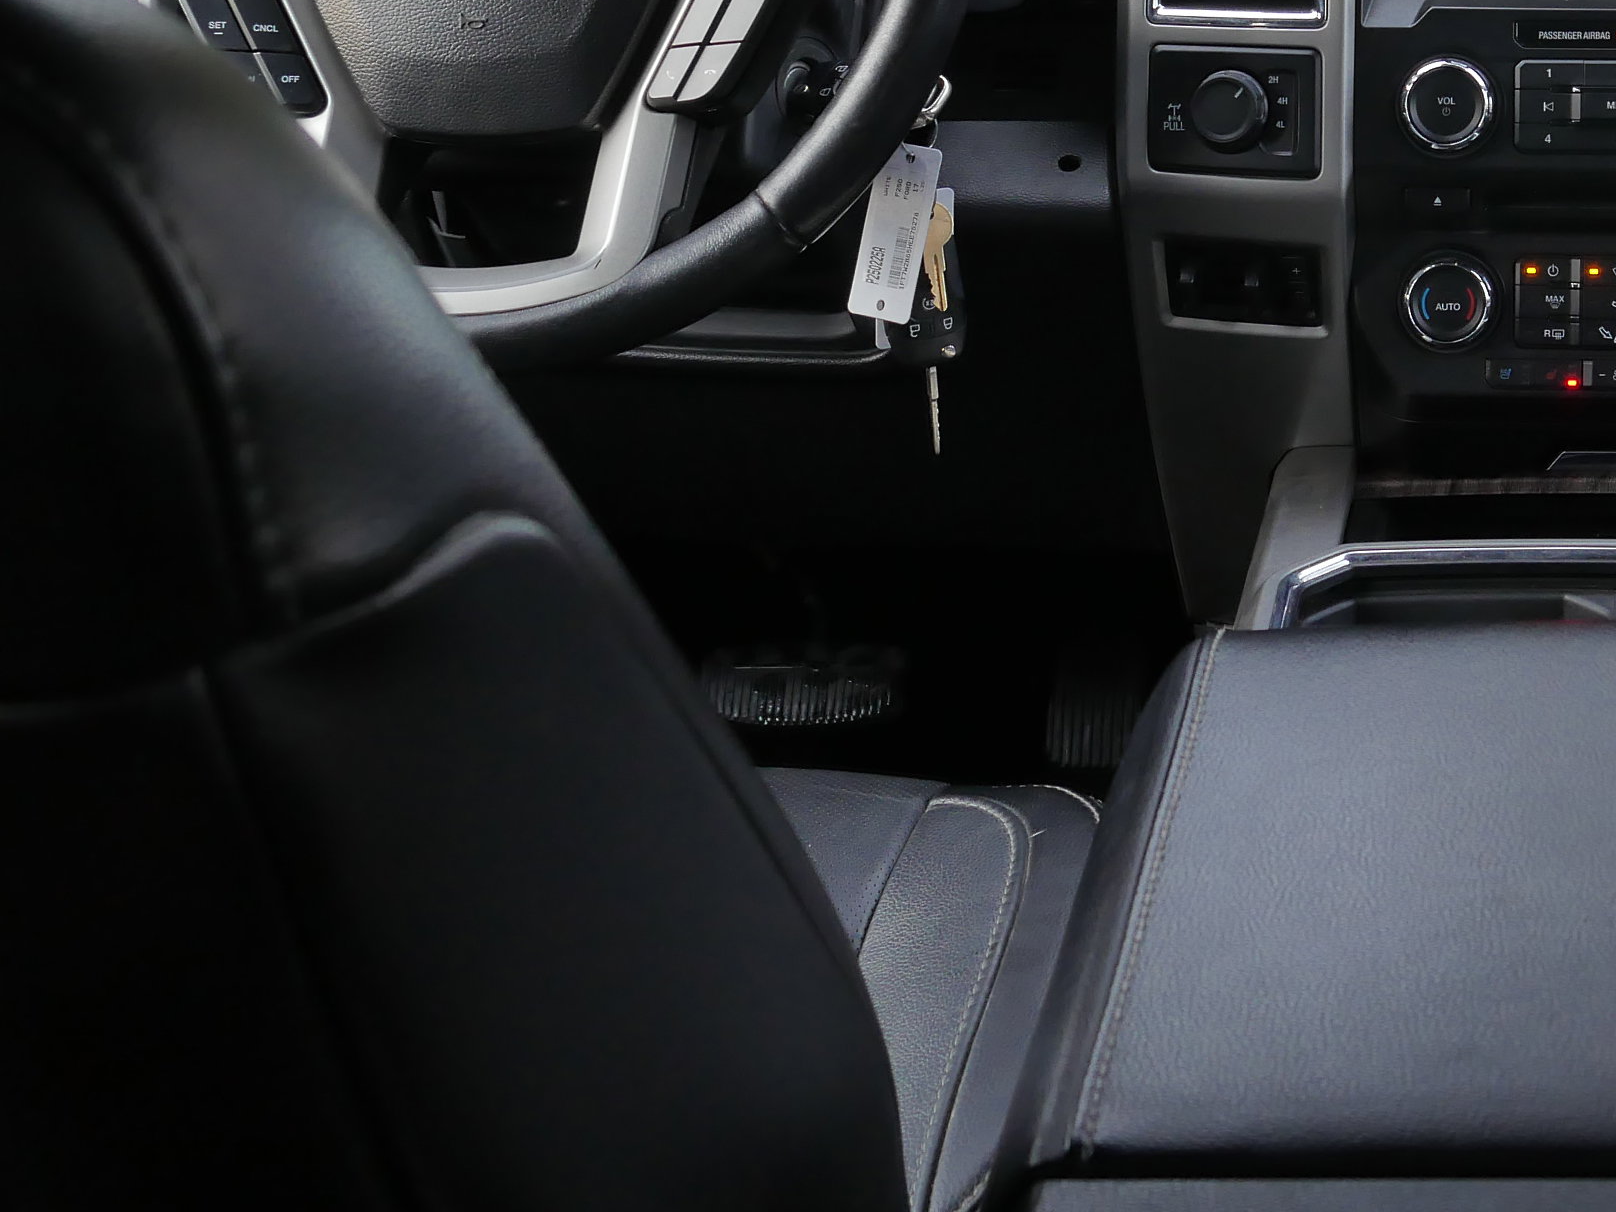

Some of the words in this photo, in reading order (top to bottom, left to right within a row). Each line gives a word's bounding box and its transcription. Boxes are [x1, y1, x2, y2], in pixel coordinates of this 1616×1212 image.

[208, 20, 228, 30] SET
[252, 23, 279, 33] CNCL
[1538, 30, 1583, 41] PASSENGER
[1583, 31, 1611, 41] AIRBAG
[1546, 68, 1552, 79] 1
[280, 75, 301, 84] OFF
[1267, 75, 1280, 85] 2H
[1276, 96, 1288, 106] 4H
[1436, 96, 1456, 106] VOL
[1163, 121, 1186, 132] PULL
[1275, 120, 1286, 129] 4L
[1544, 133, 1552, 144] 4
[1545, 294, 1565, 304] MAX
[1435, 302, 1461, 312] AUTO
